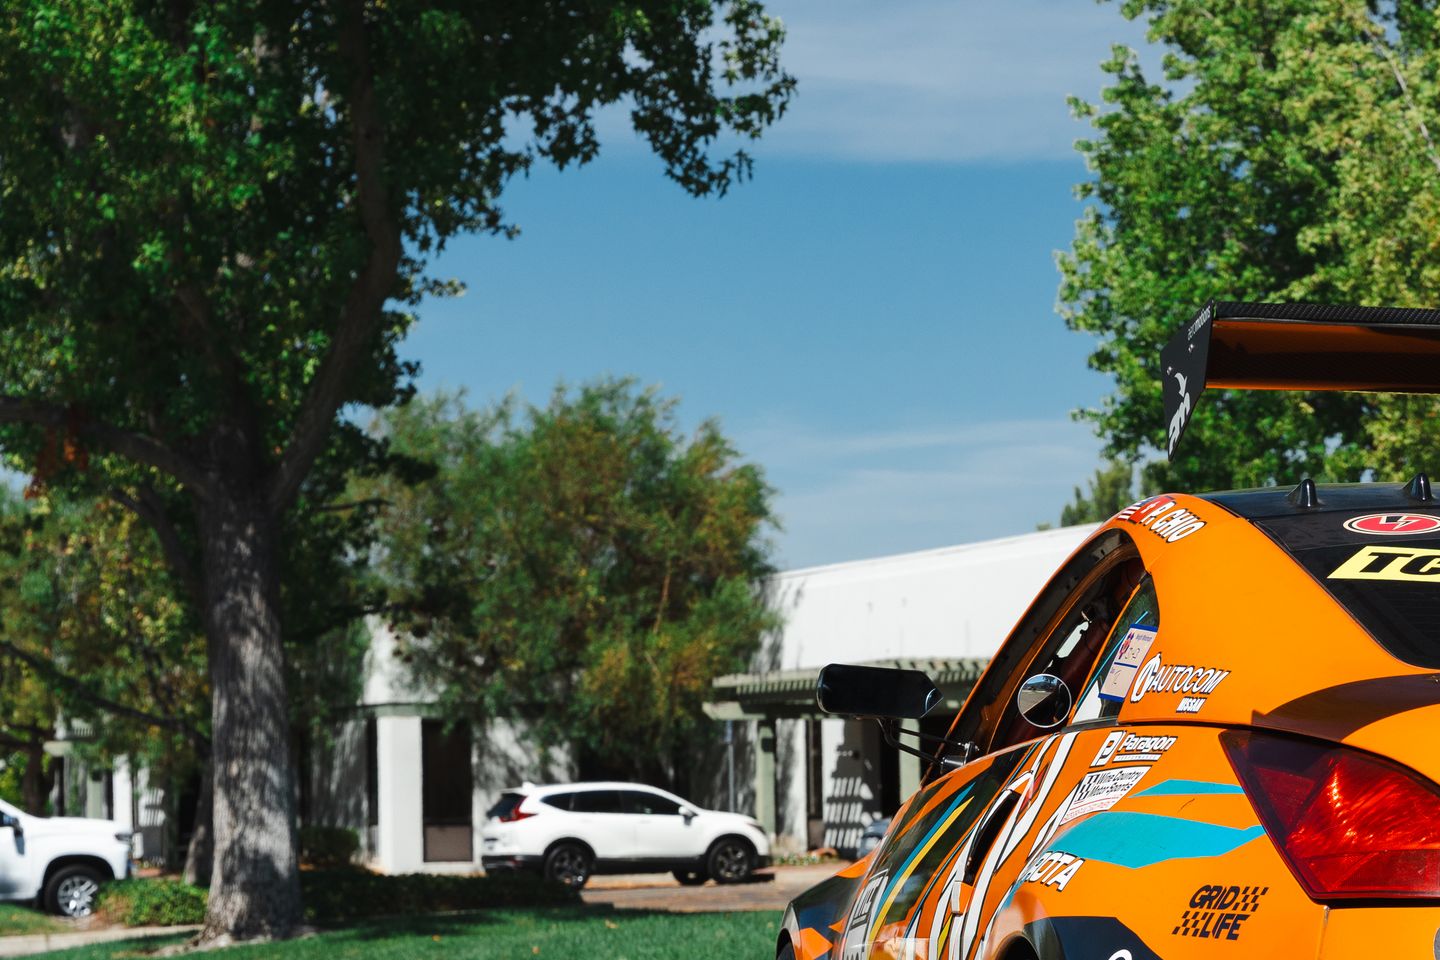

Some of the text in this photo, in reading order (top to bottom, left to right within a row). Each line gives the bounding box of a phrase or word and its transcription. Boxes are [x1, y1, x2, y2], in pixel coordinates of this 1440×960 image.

[1147, 664, 1232, 695] AUTOCOM
[1117, 732, 1178, 753] Paragon
[1189, 884, 1241, 911] GRID
[1198, 912, 1251, 941] LIFE
